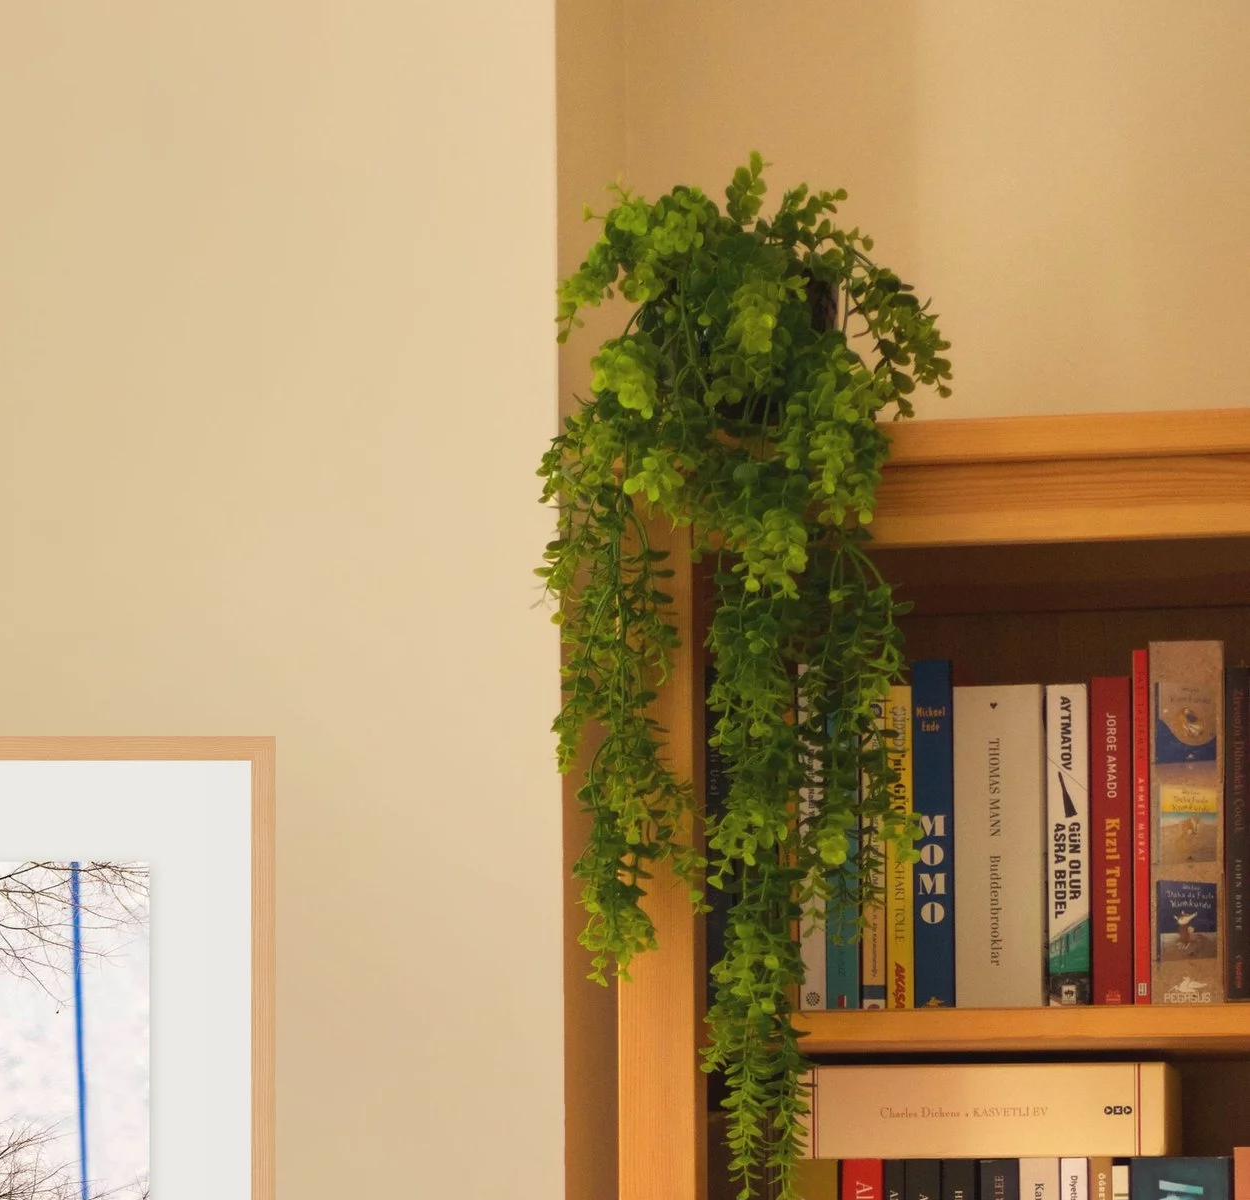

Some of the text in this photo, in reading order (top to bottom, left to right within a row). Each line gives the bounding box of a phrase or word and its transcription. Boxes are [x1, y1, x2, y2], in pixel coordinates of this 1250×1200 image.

[916, 705, 946, 718] Michael
[921, 721, 939, 732] Ende
[1059, 696, 1073, 771] AYTMATOV
[1106, 712, 1117, 799] JORGE AMADO
[918, 815, 946, 924] MOMO
[988, 738, 1001, 967] THOMAS MANN Buddenbrooklar
[1054, 823, 1067, 919] ASRA BEDEL
[1068, 822, 1082, 900] GÜN OLUR
[1138, 823, 1146, 862] MURAT
[1104, 818, 1120, 943] Kızıl Tarlalar
[1235, 859, 1243, 931] JOHN BOYNE
[894, 907, 906, 942] TOLLE
[1164, 993, 1211, 1003] PEGASUS
[879, 1105, 1049, 1119] Charles Dickens KASVETLİ EV
[994, 1175, 1005, 1195] LEE
